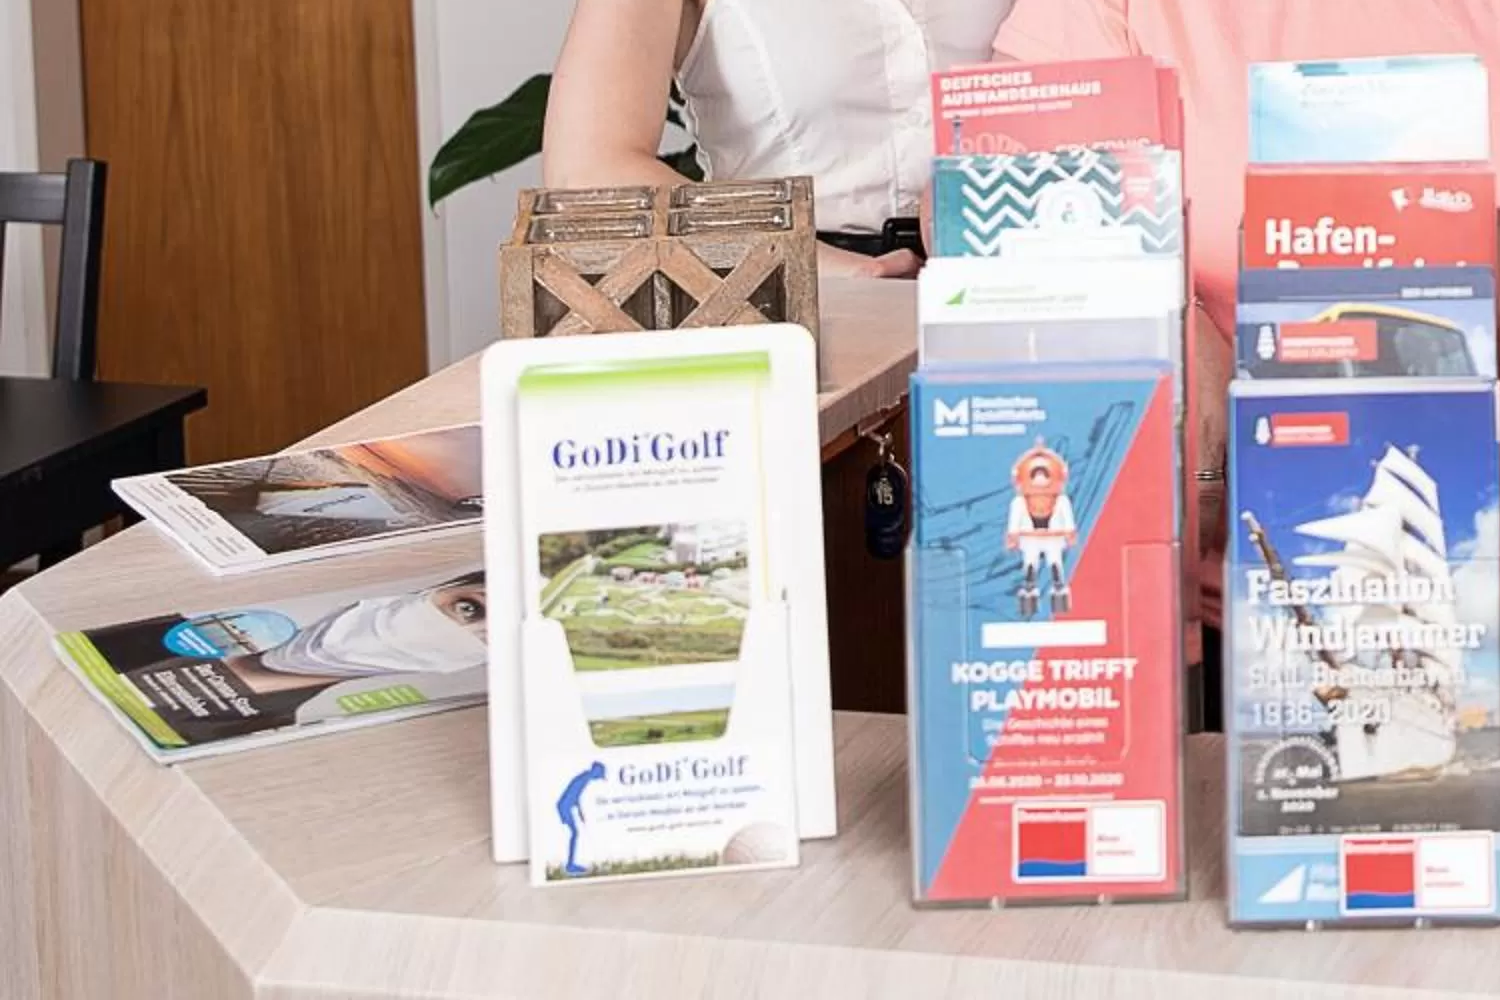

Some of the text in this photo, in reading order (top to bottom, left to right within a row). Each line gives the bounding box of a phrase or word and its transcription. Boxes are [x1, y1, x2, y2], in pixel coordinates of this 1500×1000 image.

[940, 71, 1033, 93] DEUTSCHES
[942, 80, 1102, 107] AUSWANDERERHAUS
[1265, 216, 1396, 255] Hafen-
[1247, 568, 1456, 607] Faszination
[1249, 614, 1487, 659] Windjammer
[951, 657, 1139, 684] KOGGE TRIFFT
[970, 687, 1121, 712] PLAYMOBIL
